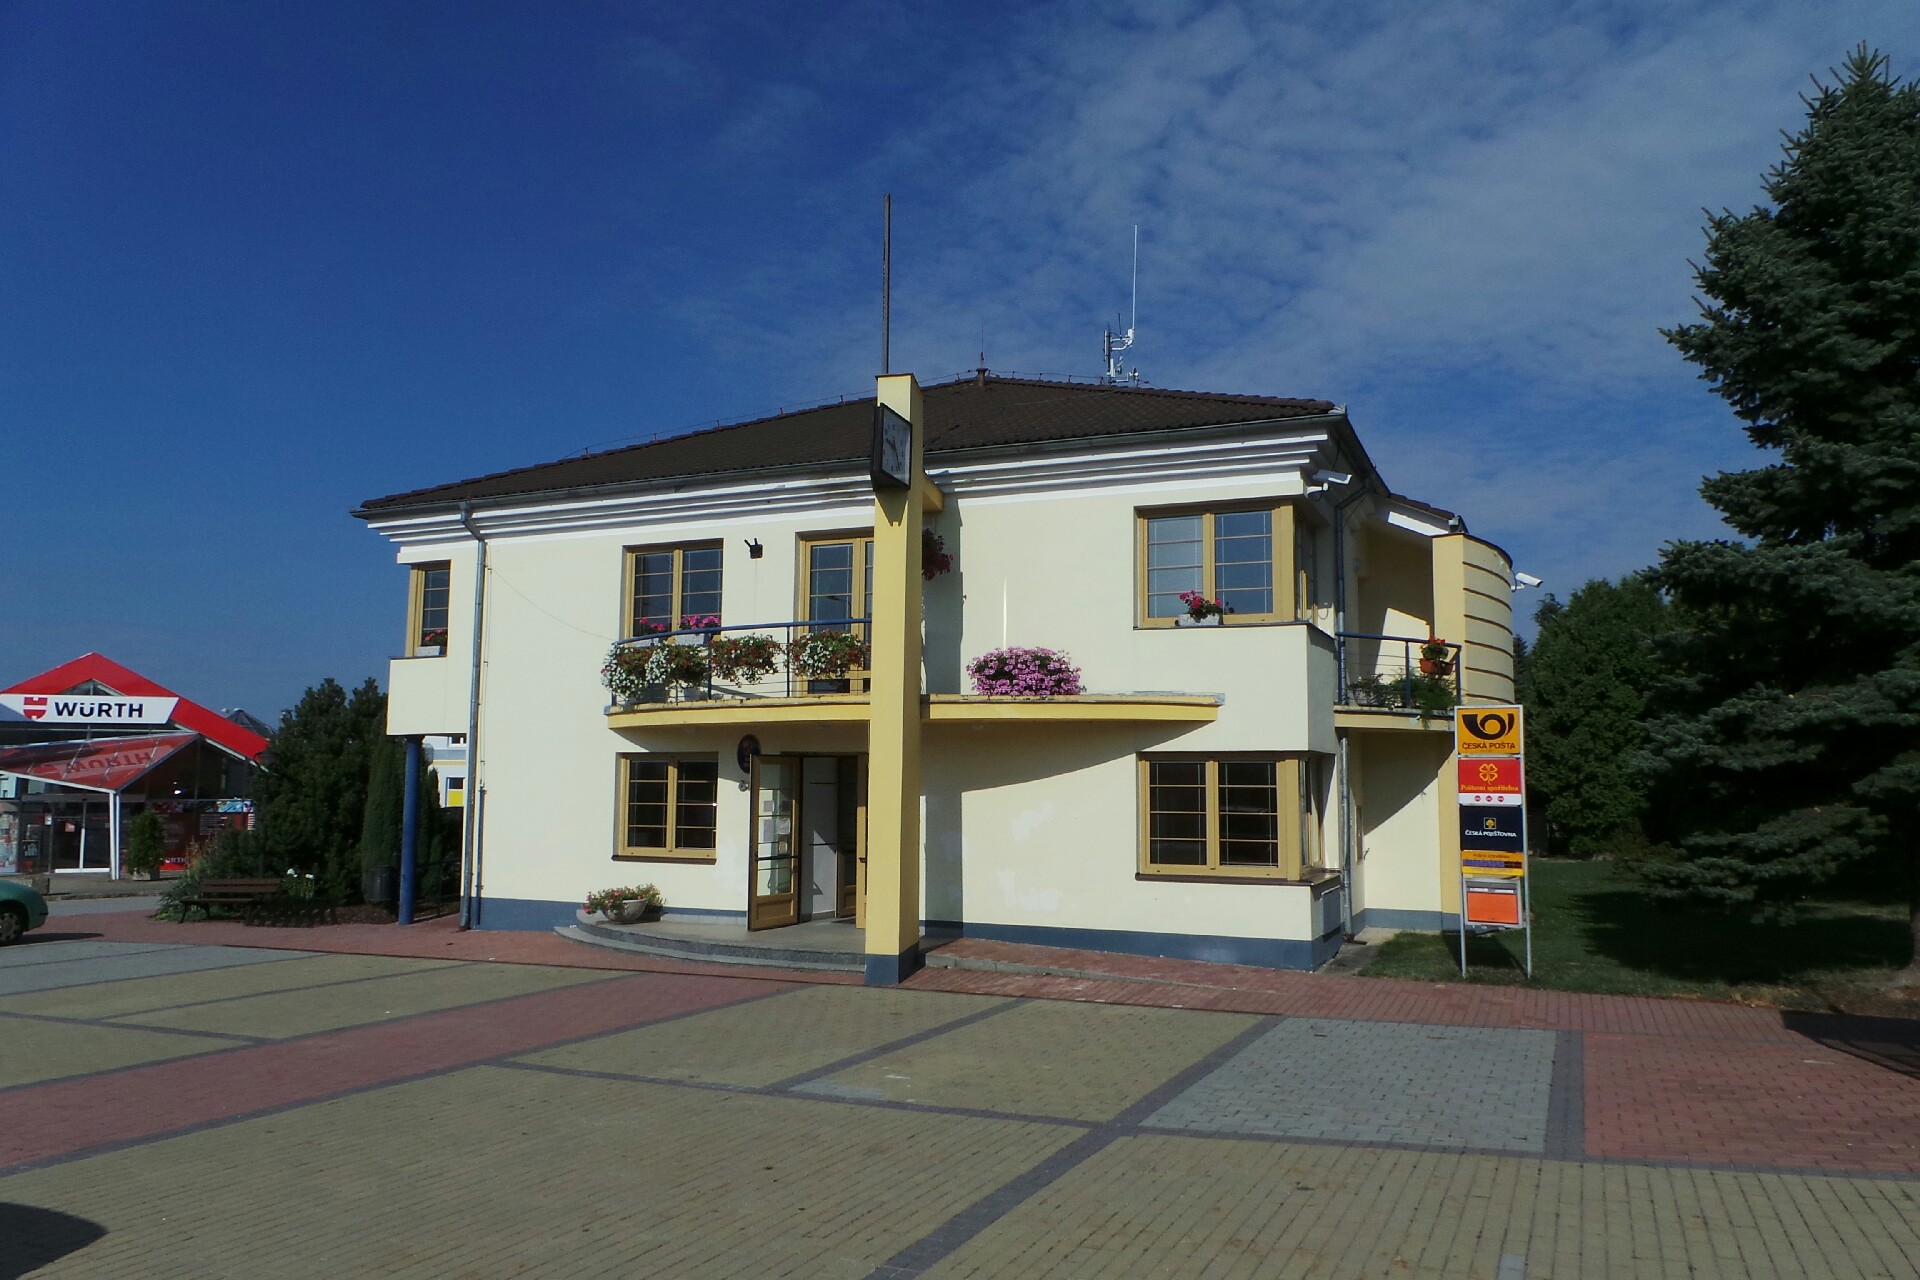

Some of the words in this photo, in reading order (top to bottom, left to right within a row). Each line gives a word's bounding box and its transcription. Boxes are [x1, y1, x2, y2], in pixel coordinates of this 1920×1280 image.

[54, 702, 144, 718] WÜRTH
[1462, 741, 1487, 750] ČESKÁ
[1489, 742, 1516, 750] POŠTA
